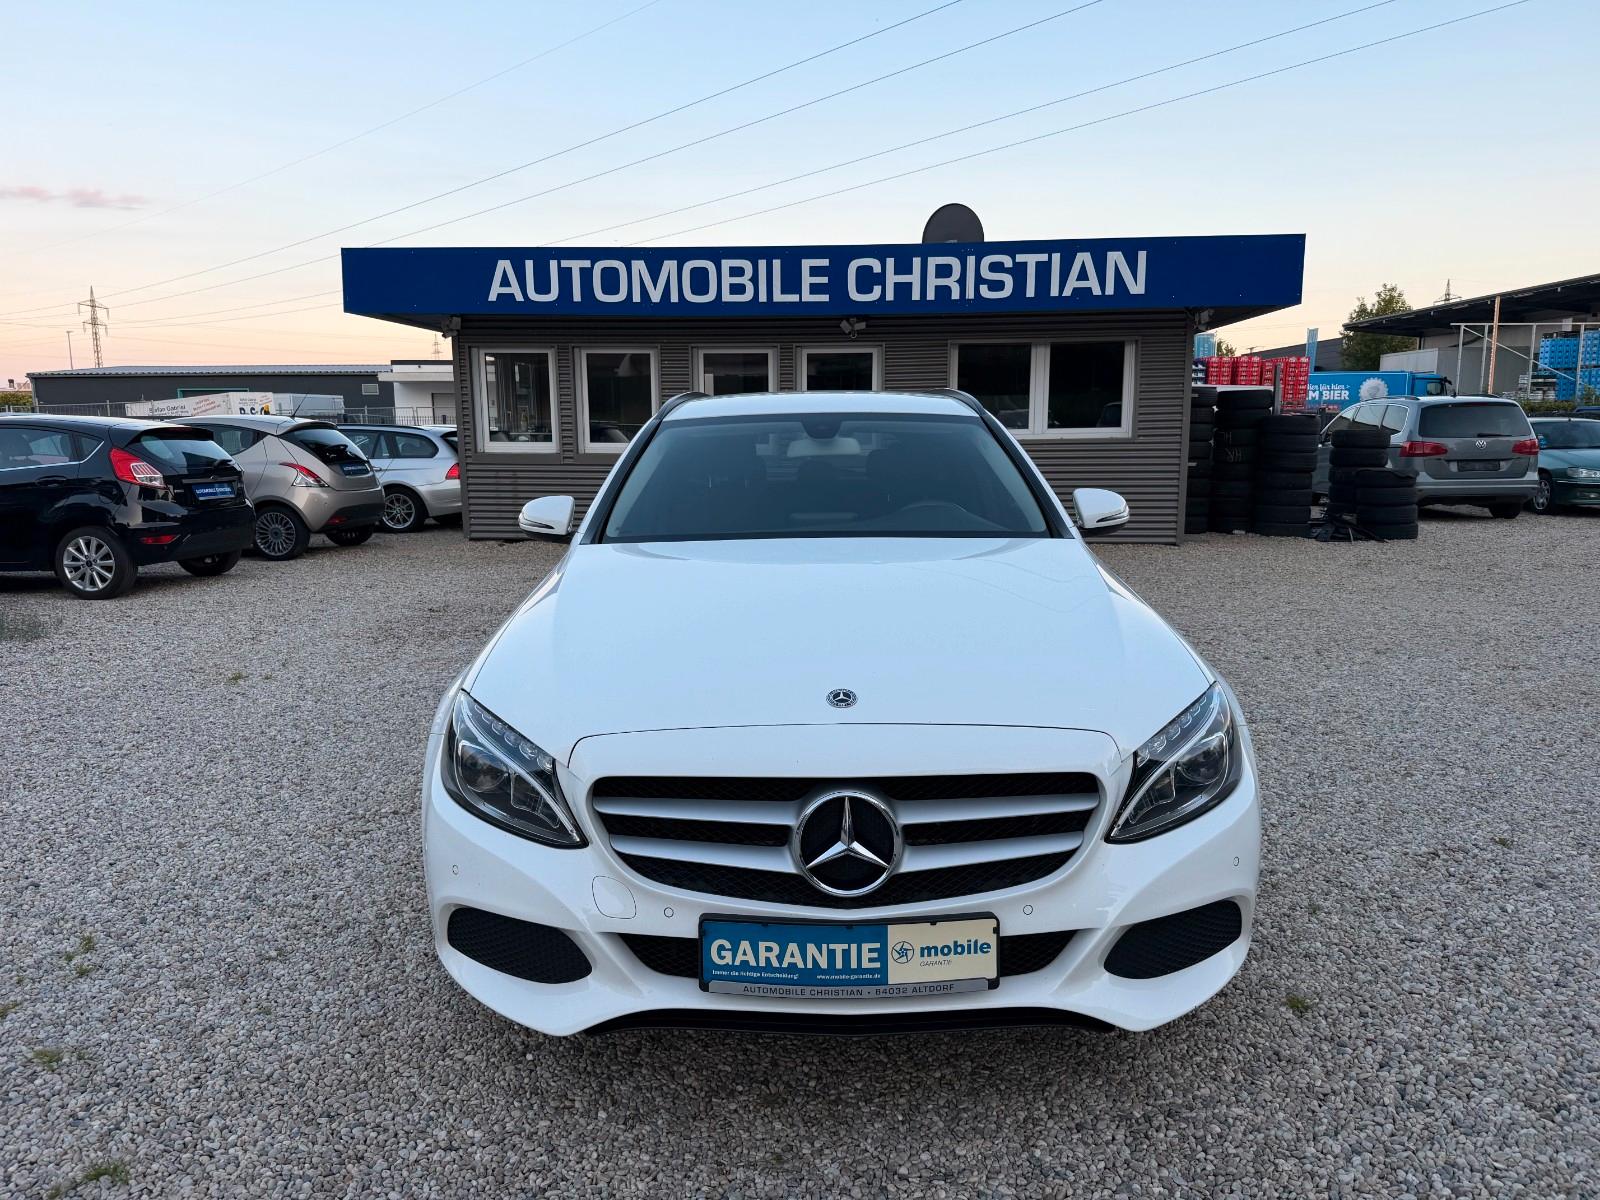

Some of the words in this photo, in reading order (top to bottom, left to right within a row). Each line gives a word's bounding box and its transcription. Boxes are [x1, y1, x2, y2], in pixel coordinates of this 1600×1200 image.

[488, 259, 830, 303] AUTOMOBILE
[847, 250, 1148, 302] CHRISTIAN
[1306, 390, 1320, 401] M
[1322, 390, 1350, 401] BIER
[710, 938, 881, 970] GARANTIE
[920, 939, 992, 958] mobile
[919, 959, 953, 967] GARANTIE
[743, 985, 806, 996] AUTOMOBILE
[809, 988, 863, 997] CHRISTIAN
[911, 983, 955, 994] ALTDORF
